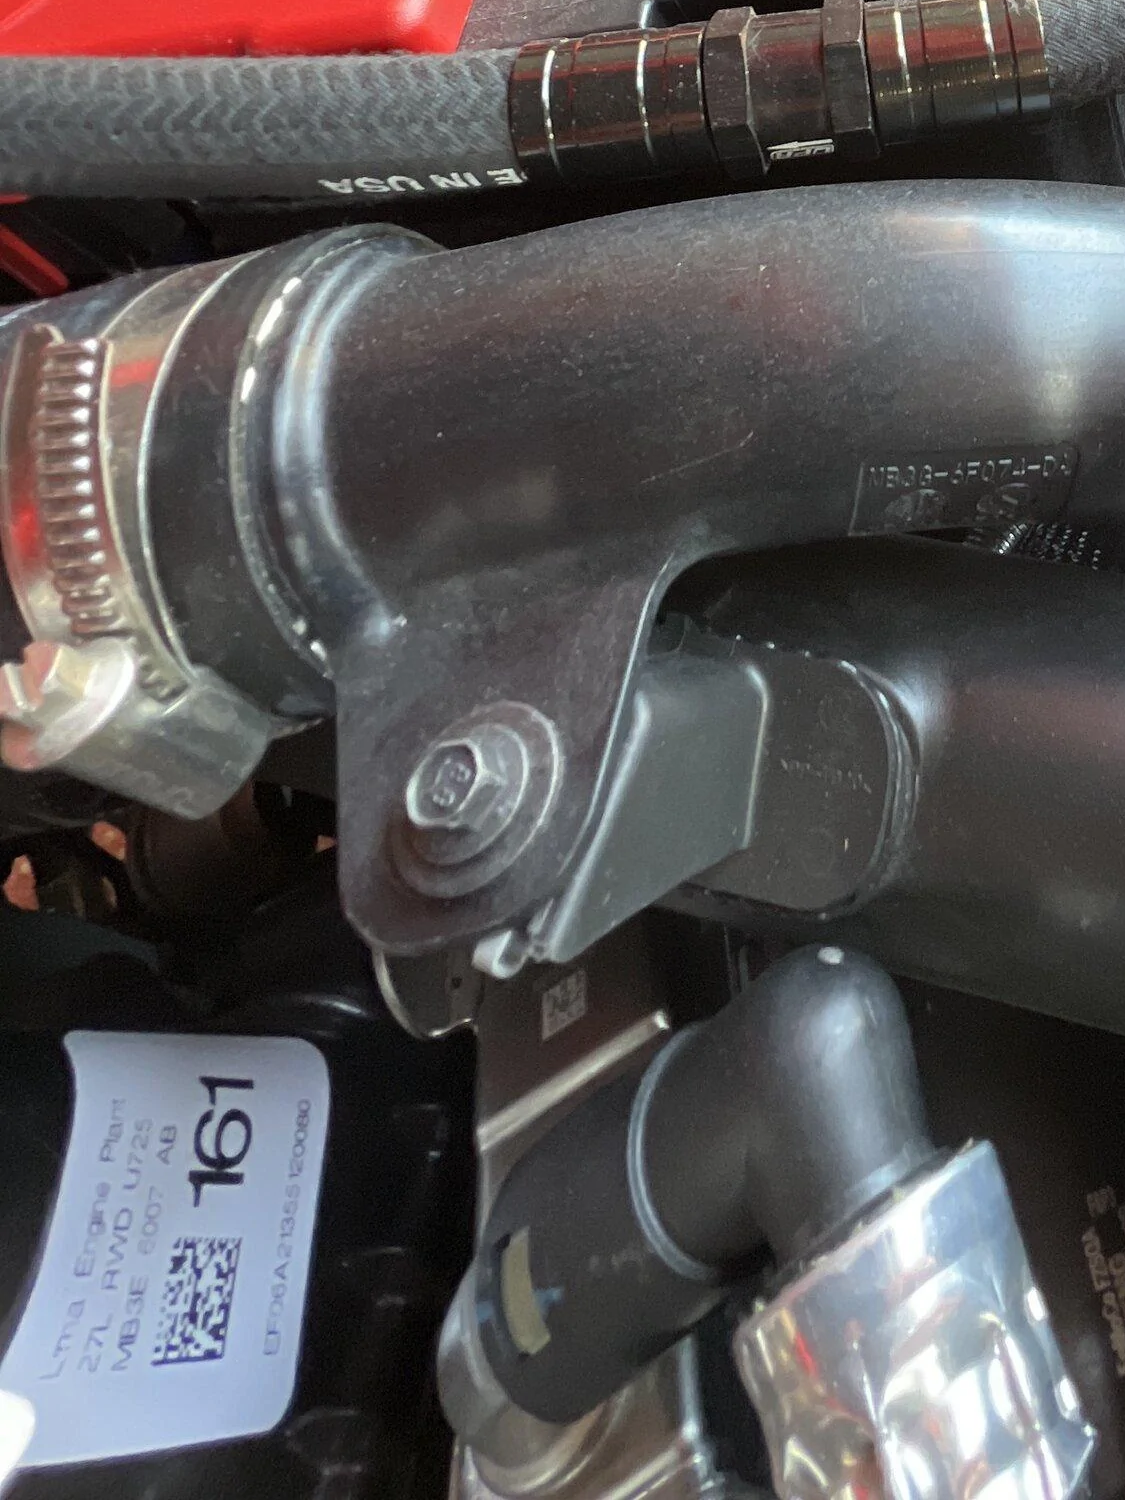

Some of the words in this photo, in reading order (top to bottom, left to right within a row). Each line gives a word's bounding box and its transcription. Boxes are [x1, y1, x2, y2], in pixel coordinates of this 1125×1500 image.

[318, 175, 425, 194] USA
[428, 171, 482, 190] IN
[100, 1097, 128, 1164] Plant
[187, 1075, 255, 1208] 161
[102, 1206, 134, 1291] RWD
[111, 1274, 151, 1373] MB3E
[157, 1122, 179, 1166] AB
